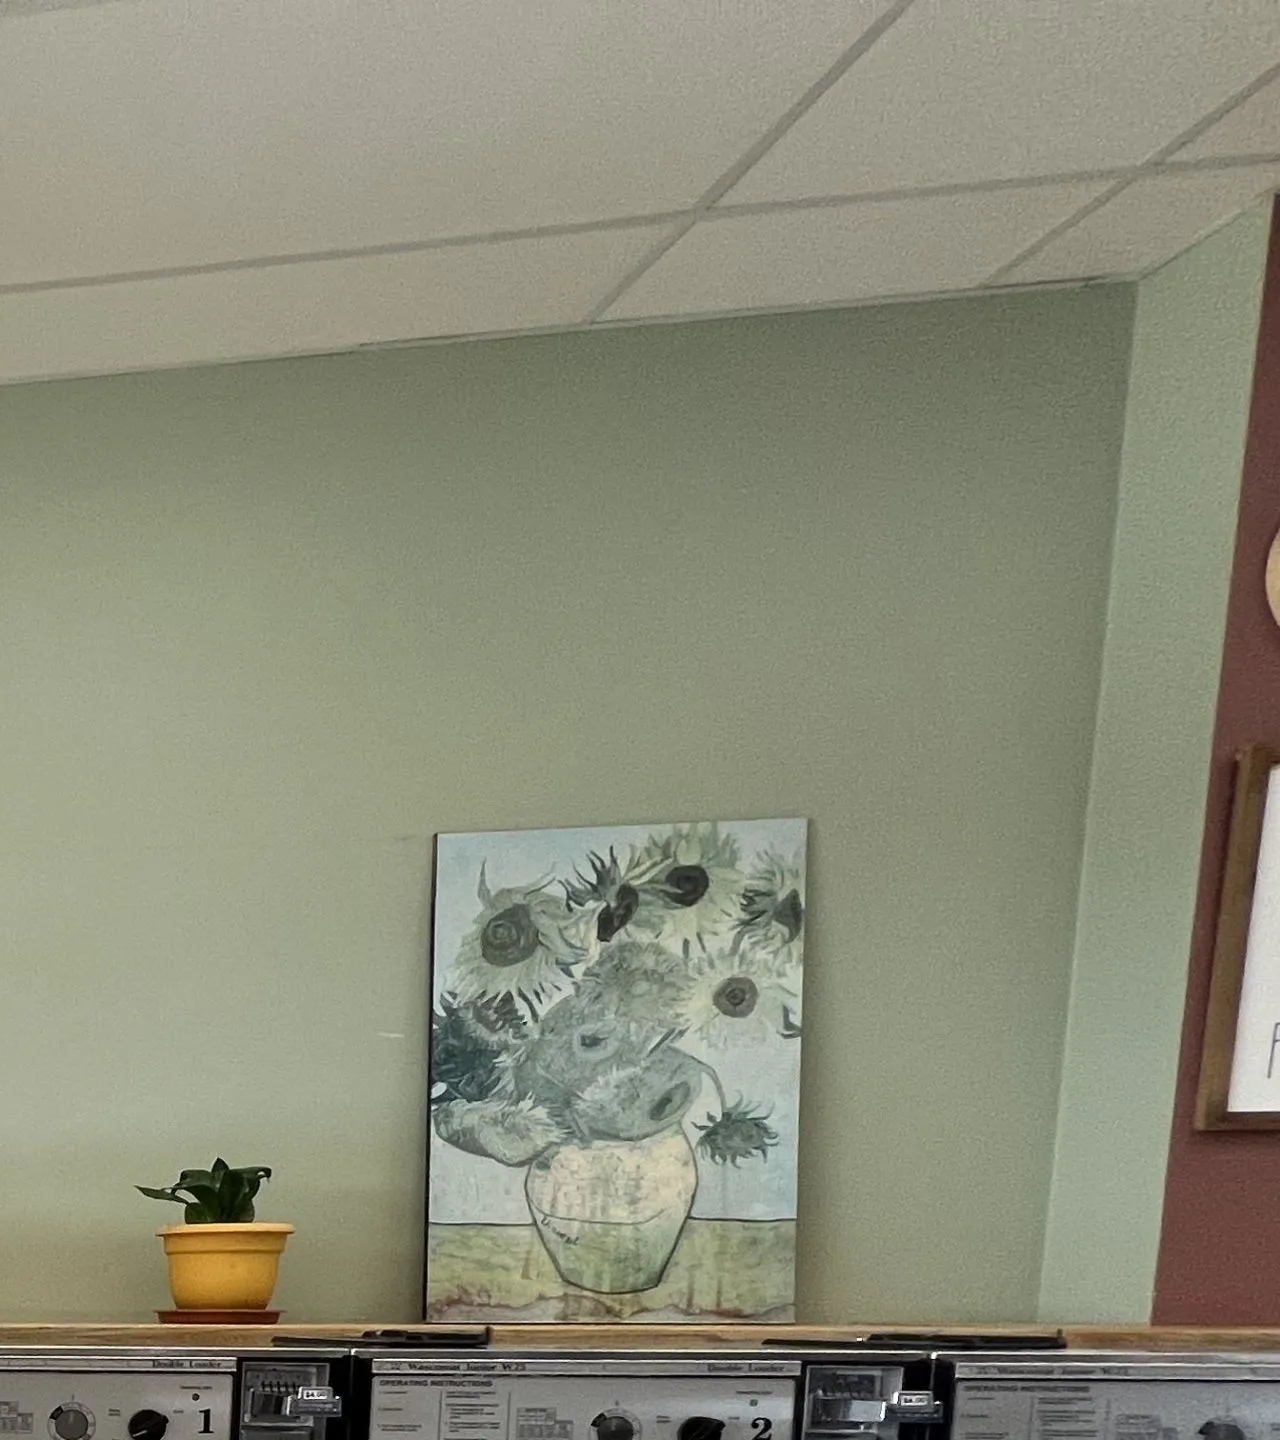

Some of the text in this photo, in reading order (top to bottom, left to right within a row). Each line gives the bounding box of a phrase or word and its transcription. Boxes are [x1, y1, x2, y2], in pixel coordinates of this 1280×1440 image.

[379, 1379, 493, 1387] OPERATING INSTRUCTIONS
[198, 1408, 214, 1433] 1
